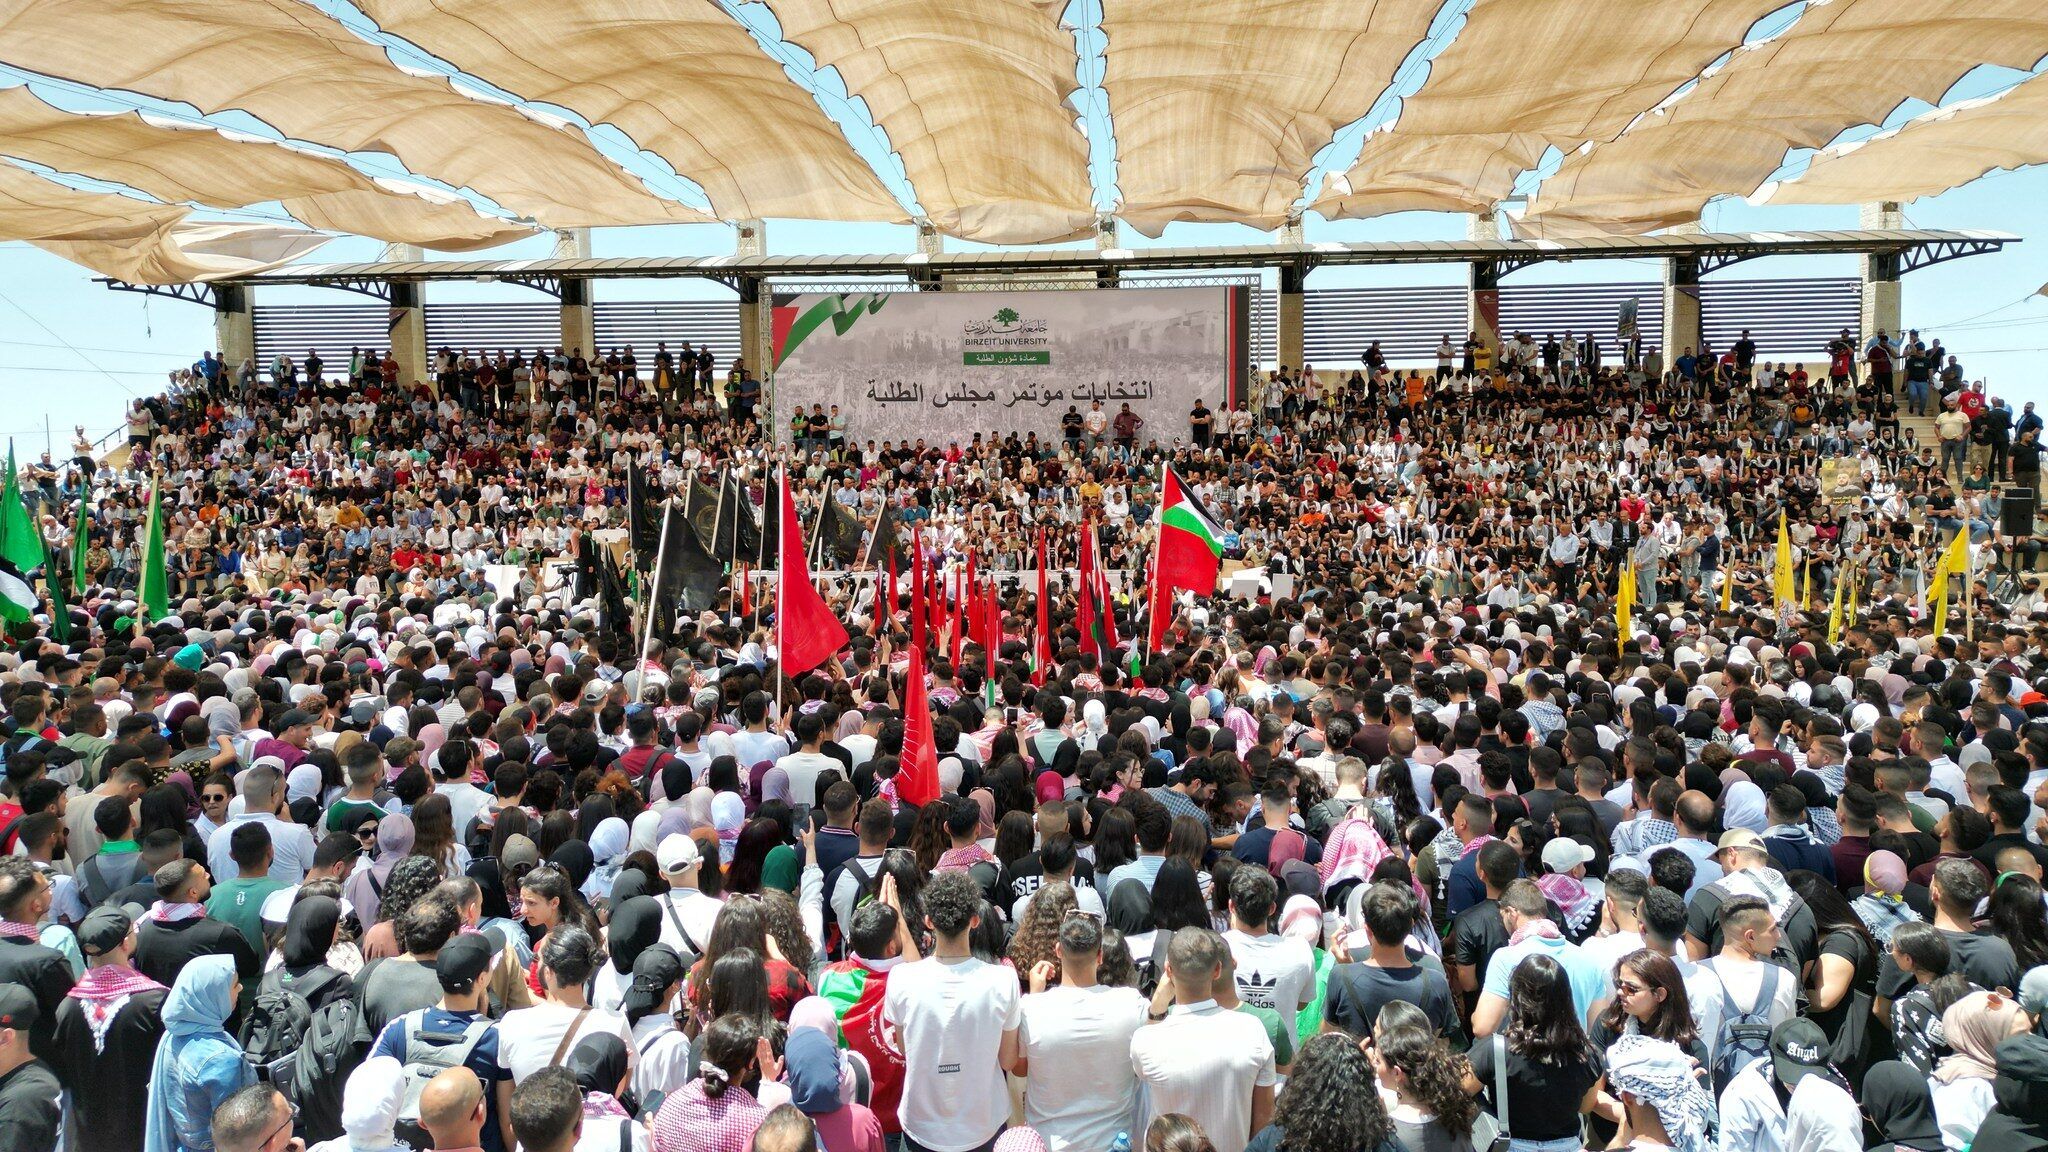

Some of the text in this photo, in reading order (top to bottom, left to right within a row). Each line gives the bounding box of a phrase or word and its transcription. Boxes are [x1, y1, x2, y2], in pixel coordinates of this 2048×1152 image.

[965, 337, 1048, 346] BIRZEIT UNIVERSITY
[976, 353, 995, 363] الطلبة
[1019, 353, 1038, 362] عمادة
[866, 379, 1153, 409] انتخابات مؤتمر مجلس الطلبة
[1787, 1041, 1819, 1062] Angel
